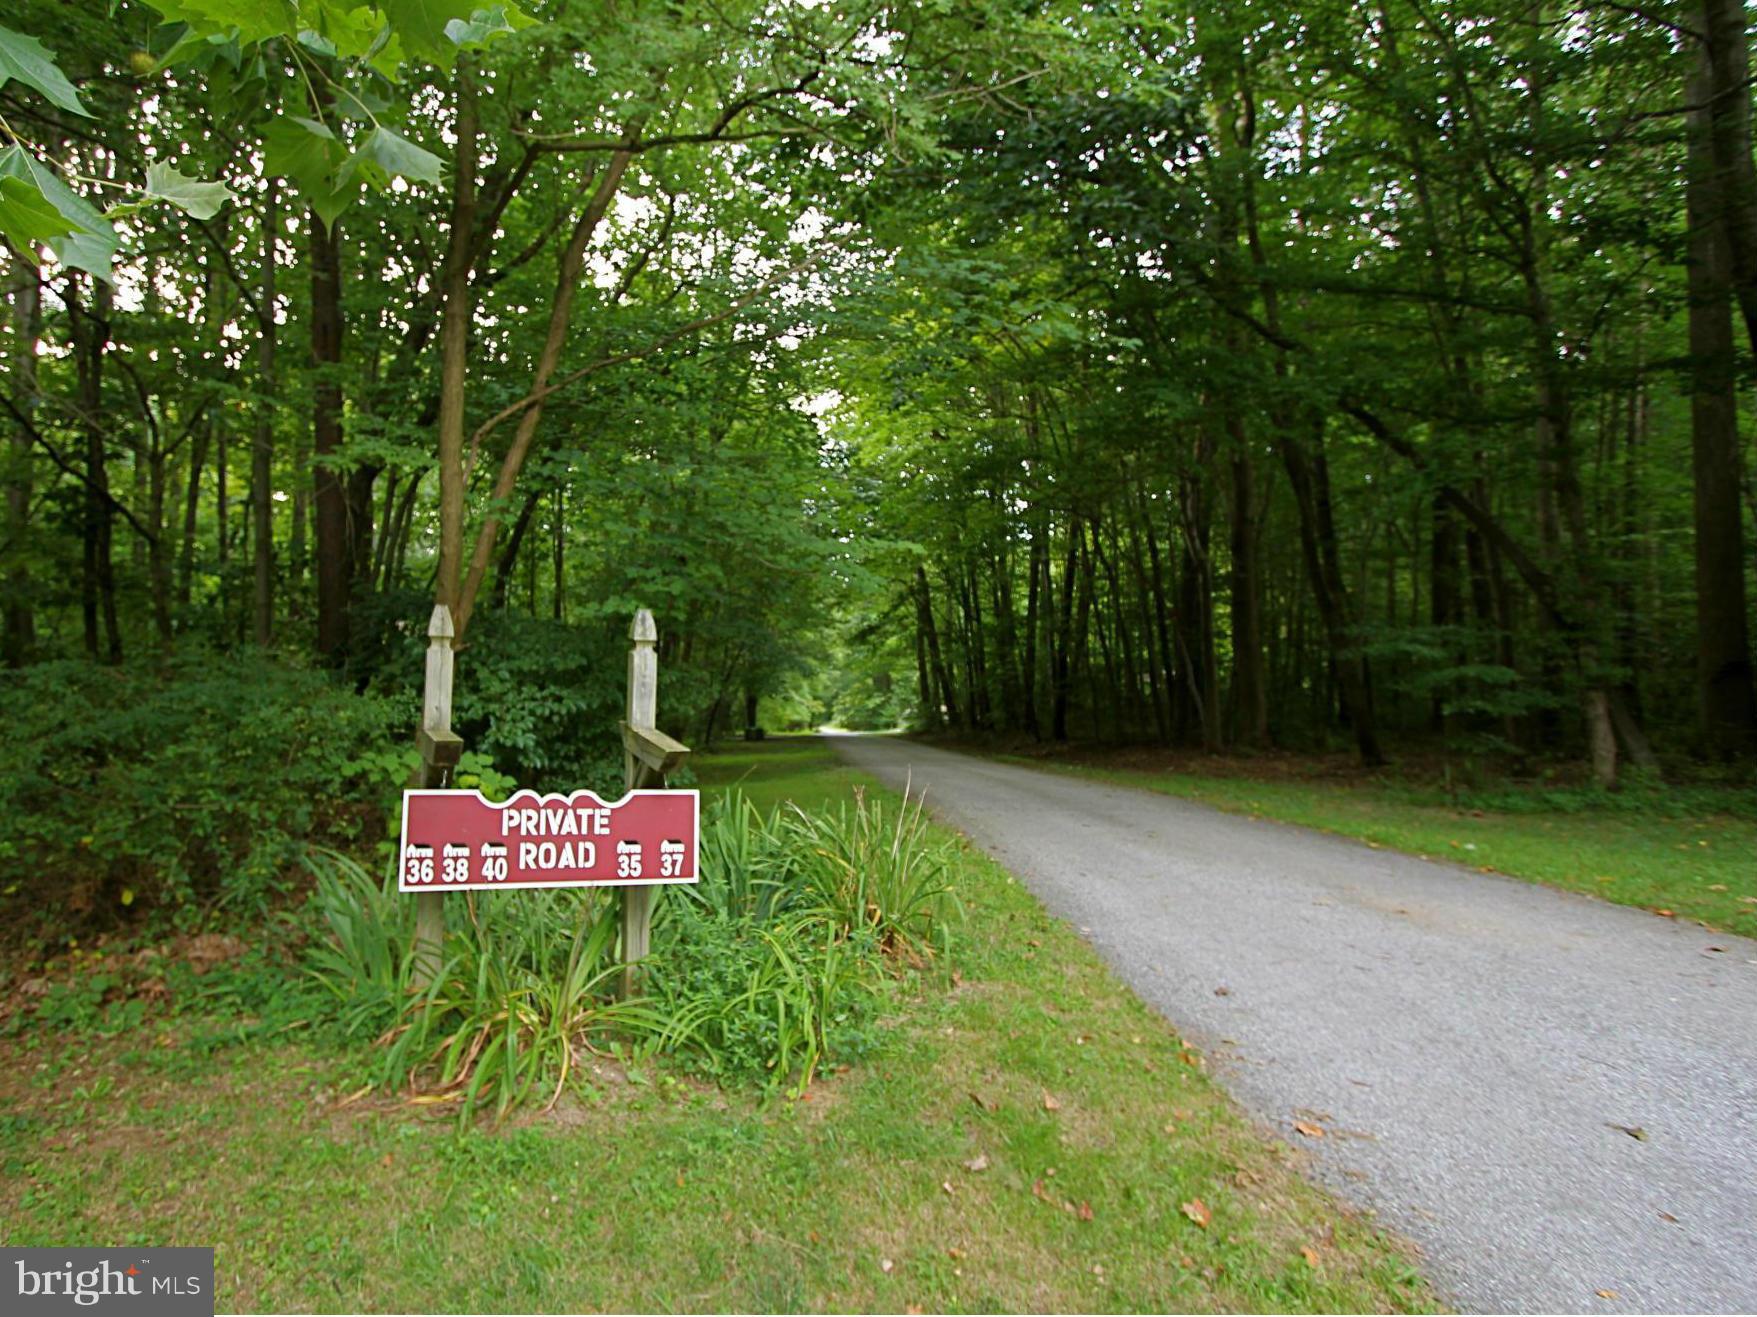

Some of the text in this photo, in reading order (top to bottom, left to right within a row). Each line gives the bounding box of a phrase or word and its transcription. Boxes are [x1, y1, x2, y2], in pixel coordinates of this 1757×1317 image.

[502, 808, 611, 836] PRIVATE
[519, 841, 596, 870] ROAD
[617, 853, 684, 878] 35 37
[406, 857, 508, 884] 36 38 40
